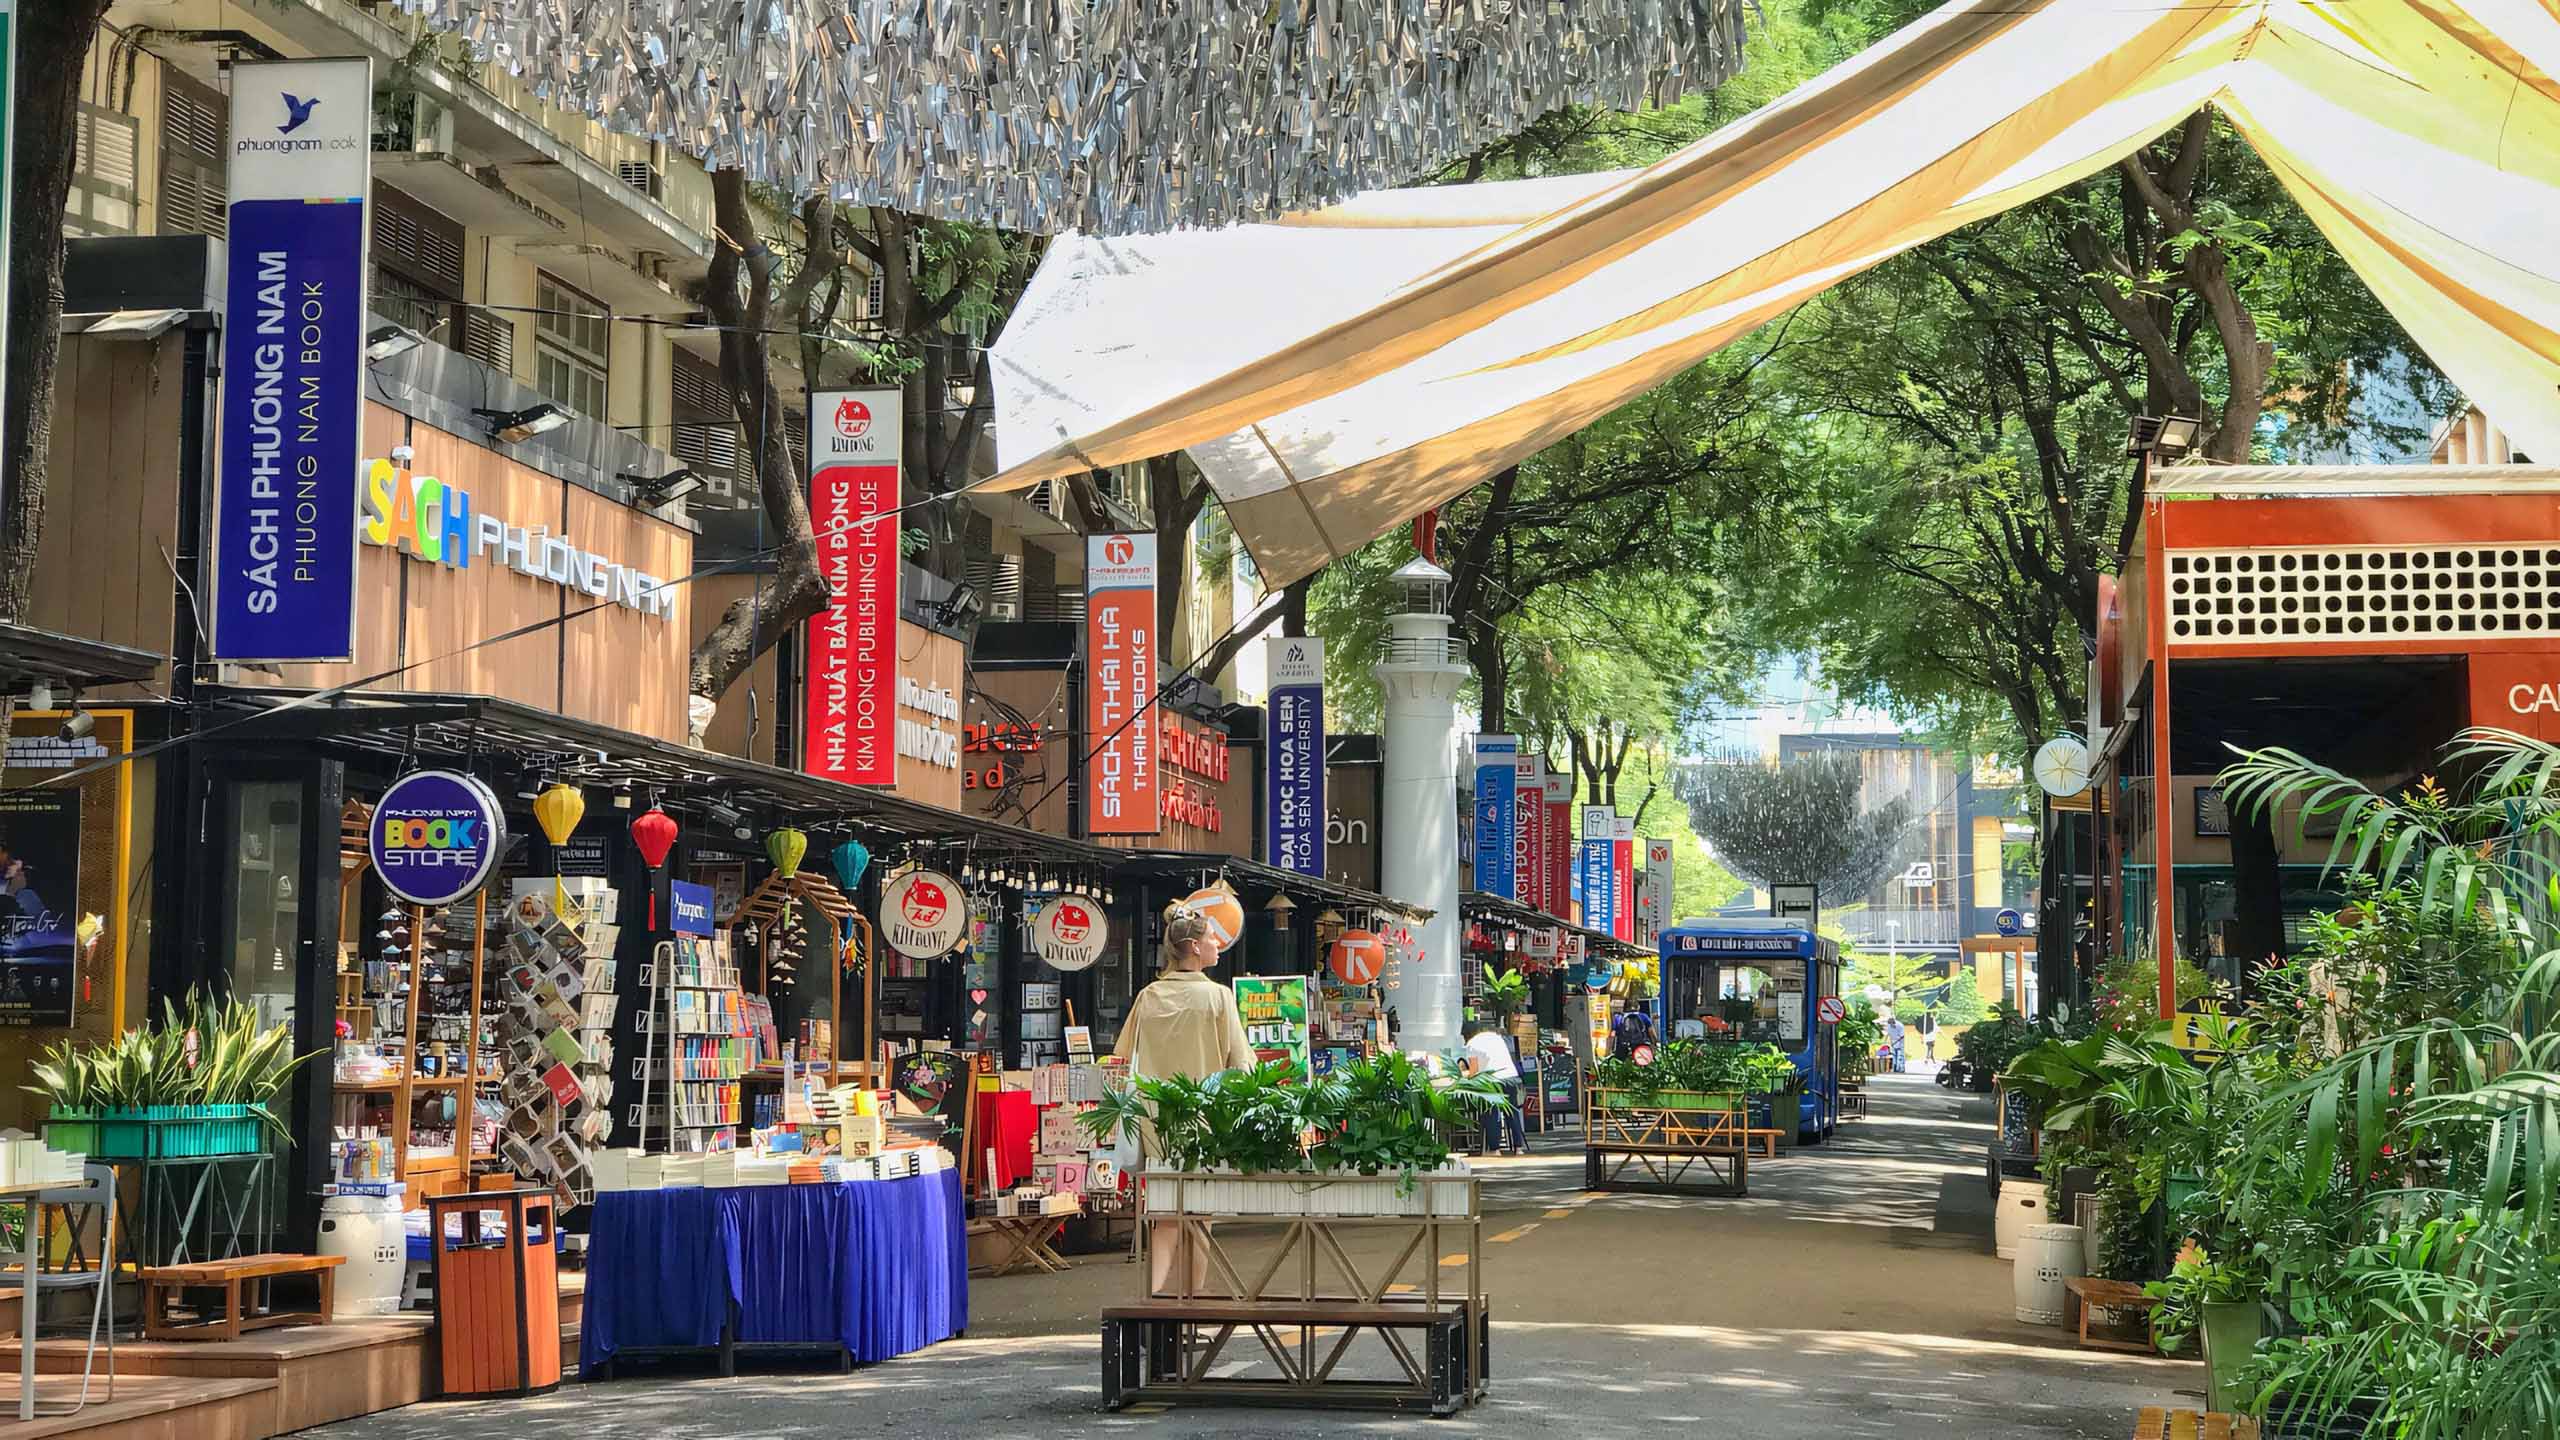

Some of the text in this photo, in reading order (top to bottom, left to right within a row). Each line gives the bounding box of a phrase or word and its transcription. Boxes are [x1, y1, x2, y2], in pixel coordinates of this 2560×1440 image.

[242, 251, 288, 613] SÁCH PHƯƠNG NAM
[294, 281, 324, 581] PHUONG NAM BOOK
[362, 446, 677, 621] SÁCH PHƯƠNG NAM
[823, 481, 849, 772] NHÀ XUẤT BẢN KIM ĐỒNG
[856, 481, 878, 772] KIM DONG PUBLISHING HOUSE
[1097, 606, 1121, 818] SÁCH THÁI HÀ
[1132, 628, 1147, 791] THAIHABOOKS
[2509, 683, 2560, 713] CA
[384, 818, 477, 849] BOOK
[384, 850, 477, 866] STORE
[1280, 695, 1299, 870] ĐẠI HỌC HOA SEN
[1298, 696, 1312, 869] HOA SEN UNIVERSITY
[2199, 998, 2228, 1014] WC
